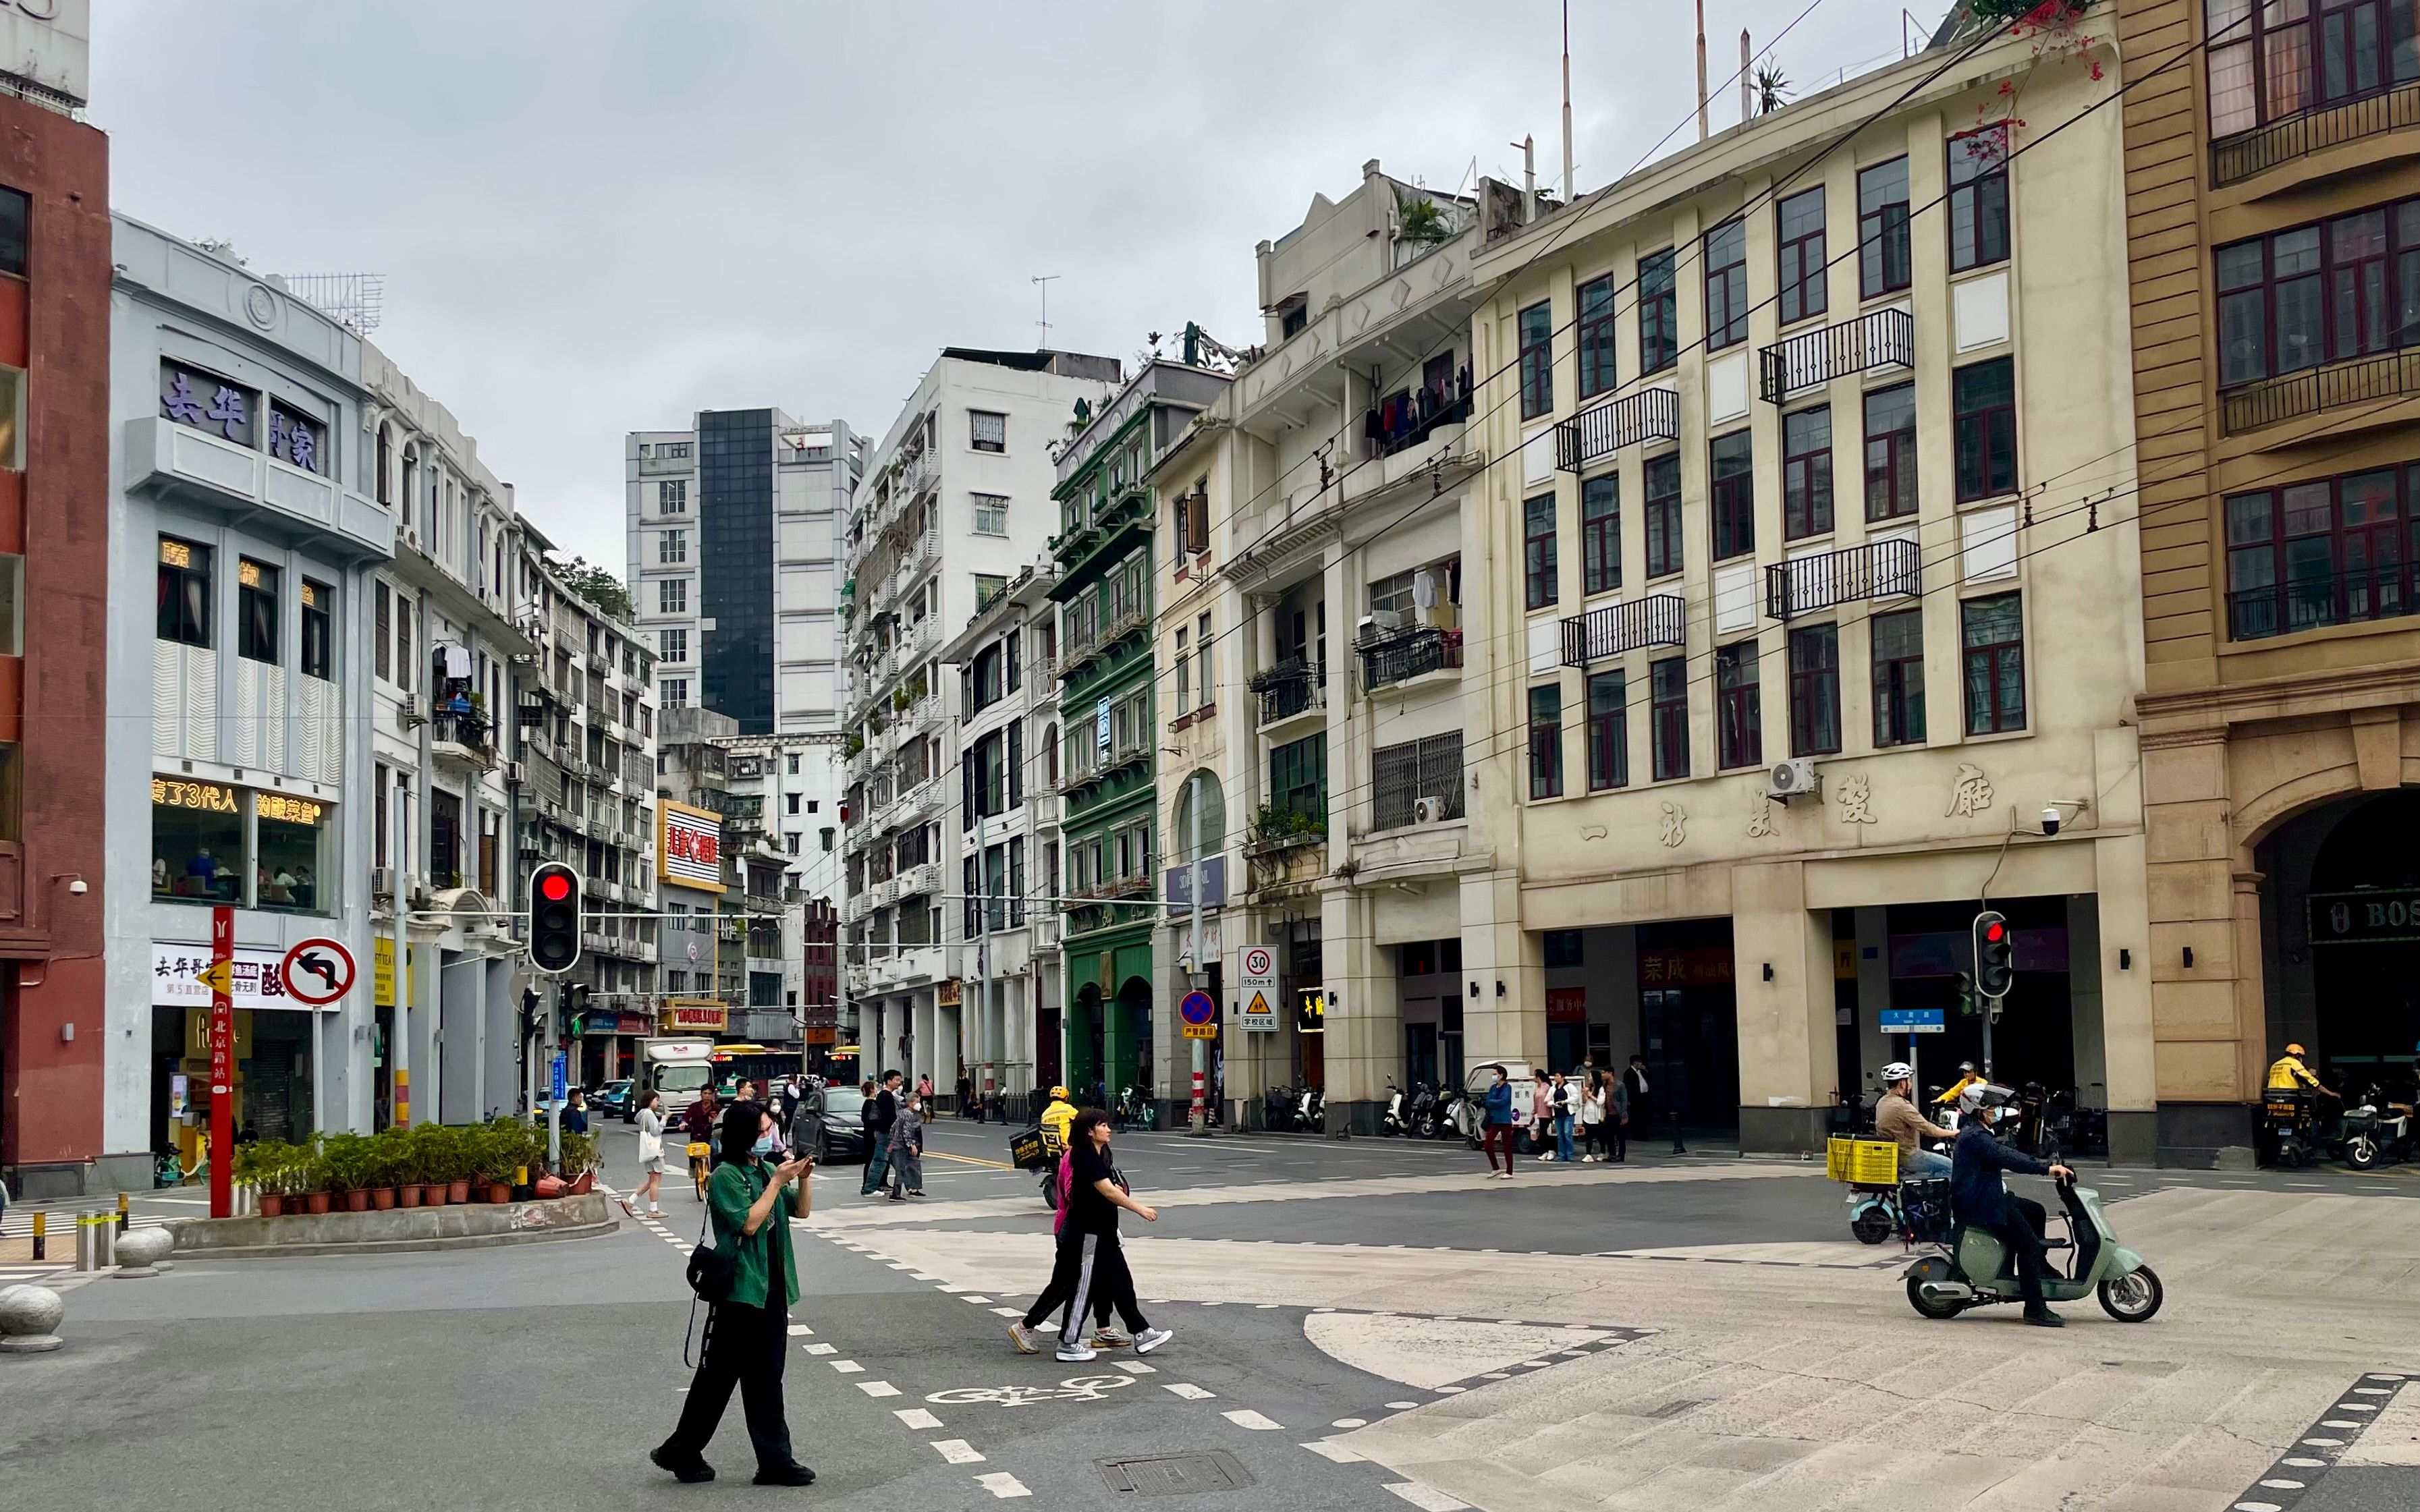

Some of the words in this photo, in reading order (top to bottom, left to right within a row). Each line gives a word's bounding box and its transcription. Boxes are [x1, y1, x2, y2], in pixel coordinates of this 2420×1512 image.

[1251, 957, 1266, 968] 30
[1185, 1027, 1213, 1036] 严管路段
[214, 1020, 226, 1079] 北京路站
